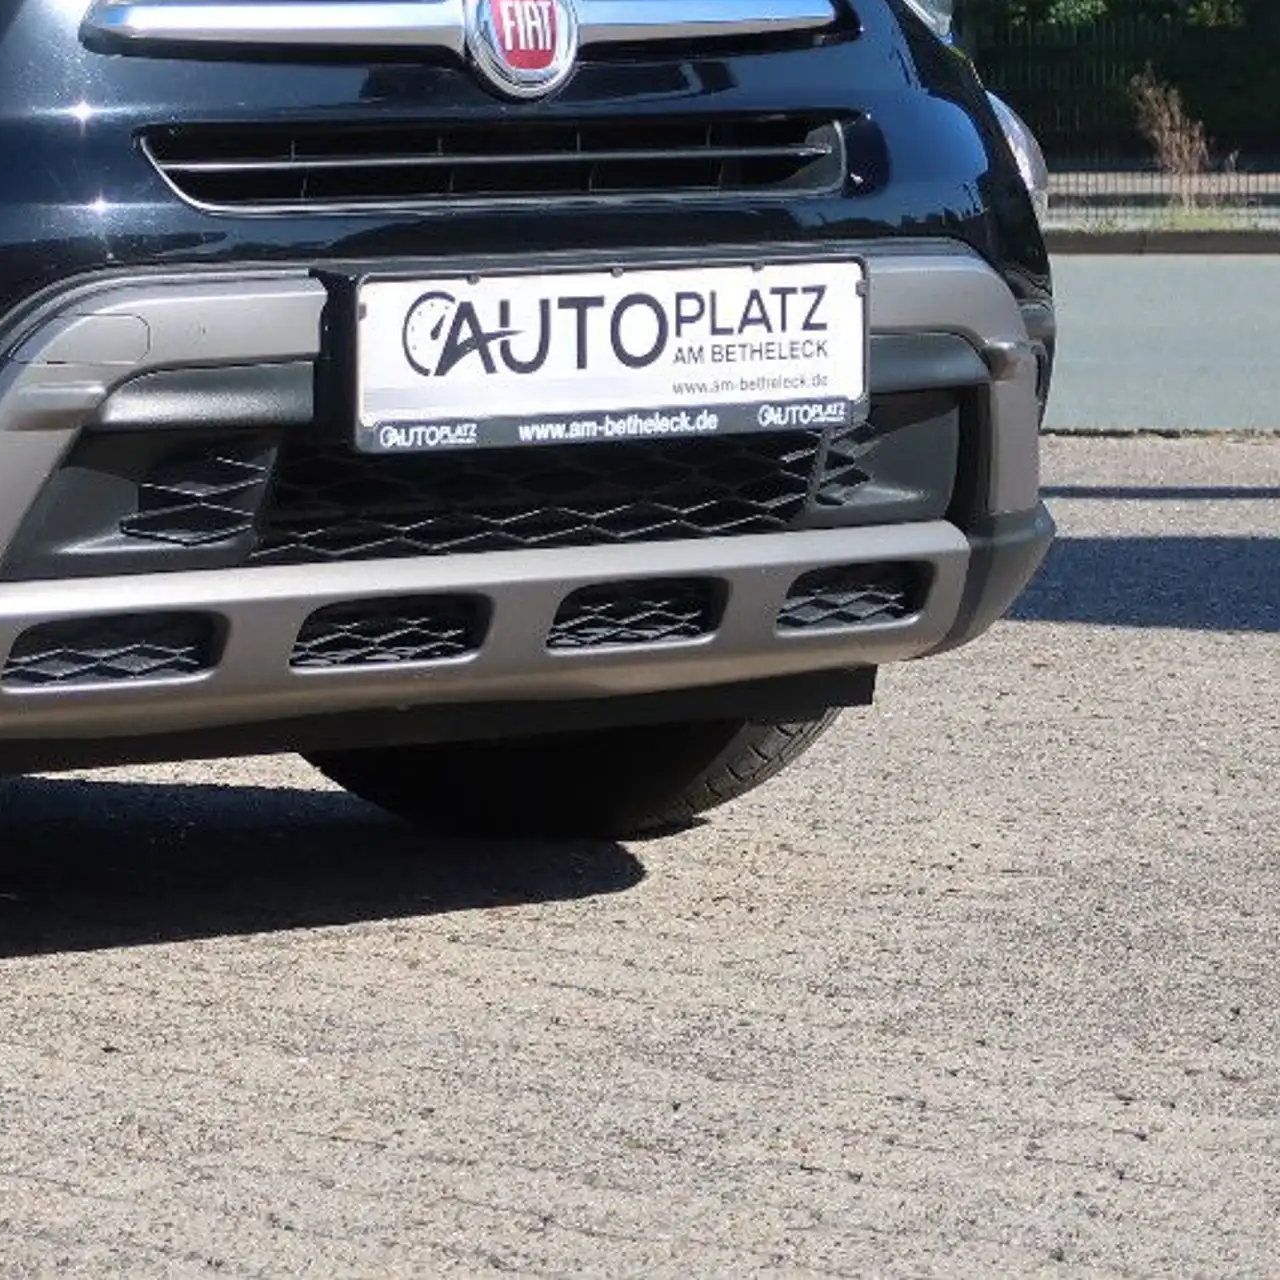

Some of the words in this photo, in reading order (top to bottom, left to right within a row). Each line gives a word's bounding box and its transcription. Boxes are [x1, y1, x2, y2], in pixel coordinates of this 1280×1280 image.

[672, 344, 706, 365] AM
[710, 338, 829, 364] BETHELECK
[672, 373, 829, 396] www.am-betheleck.de
[518, 409, 719, 442] www.am-betheleck.de
